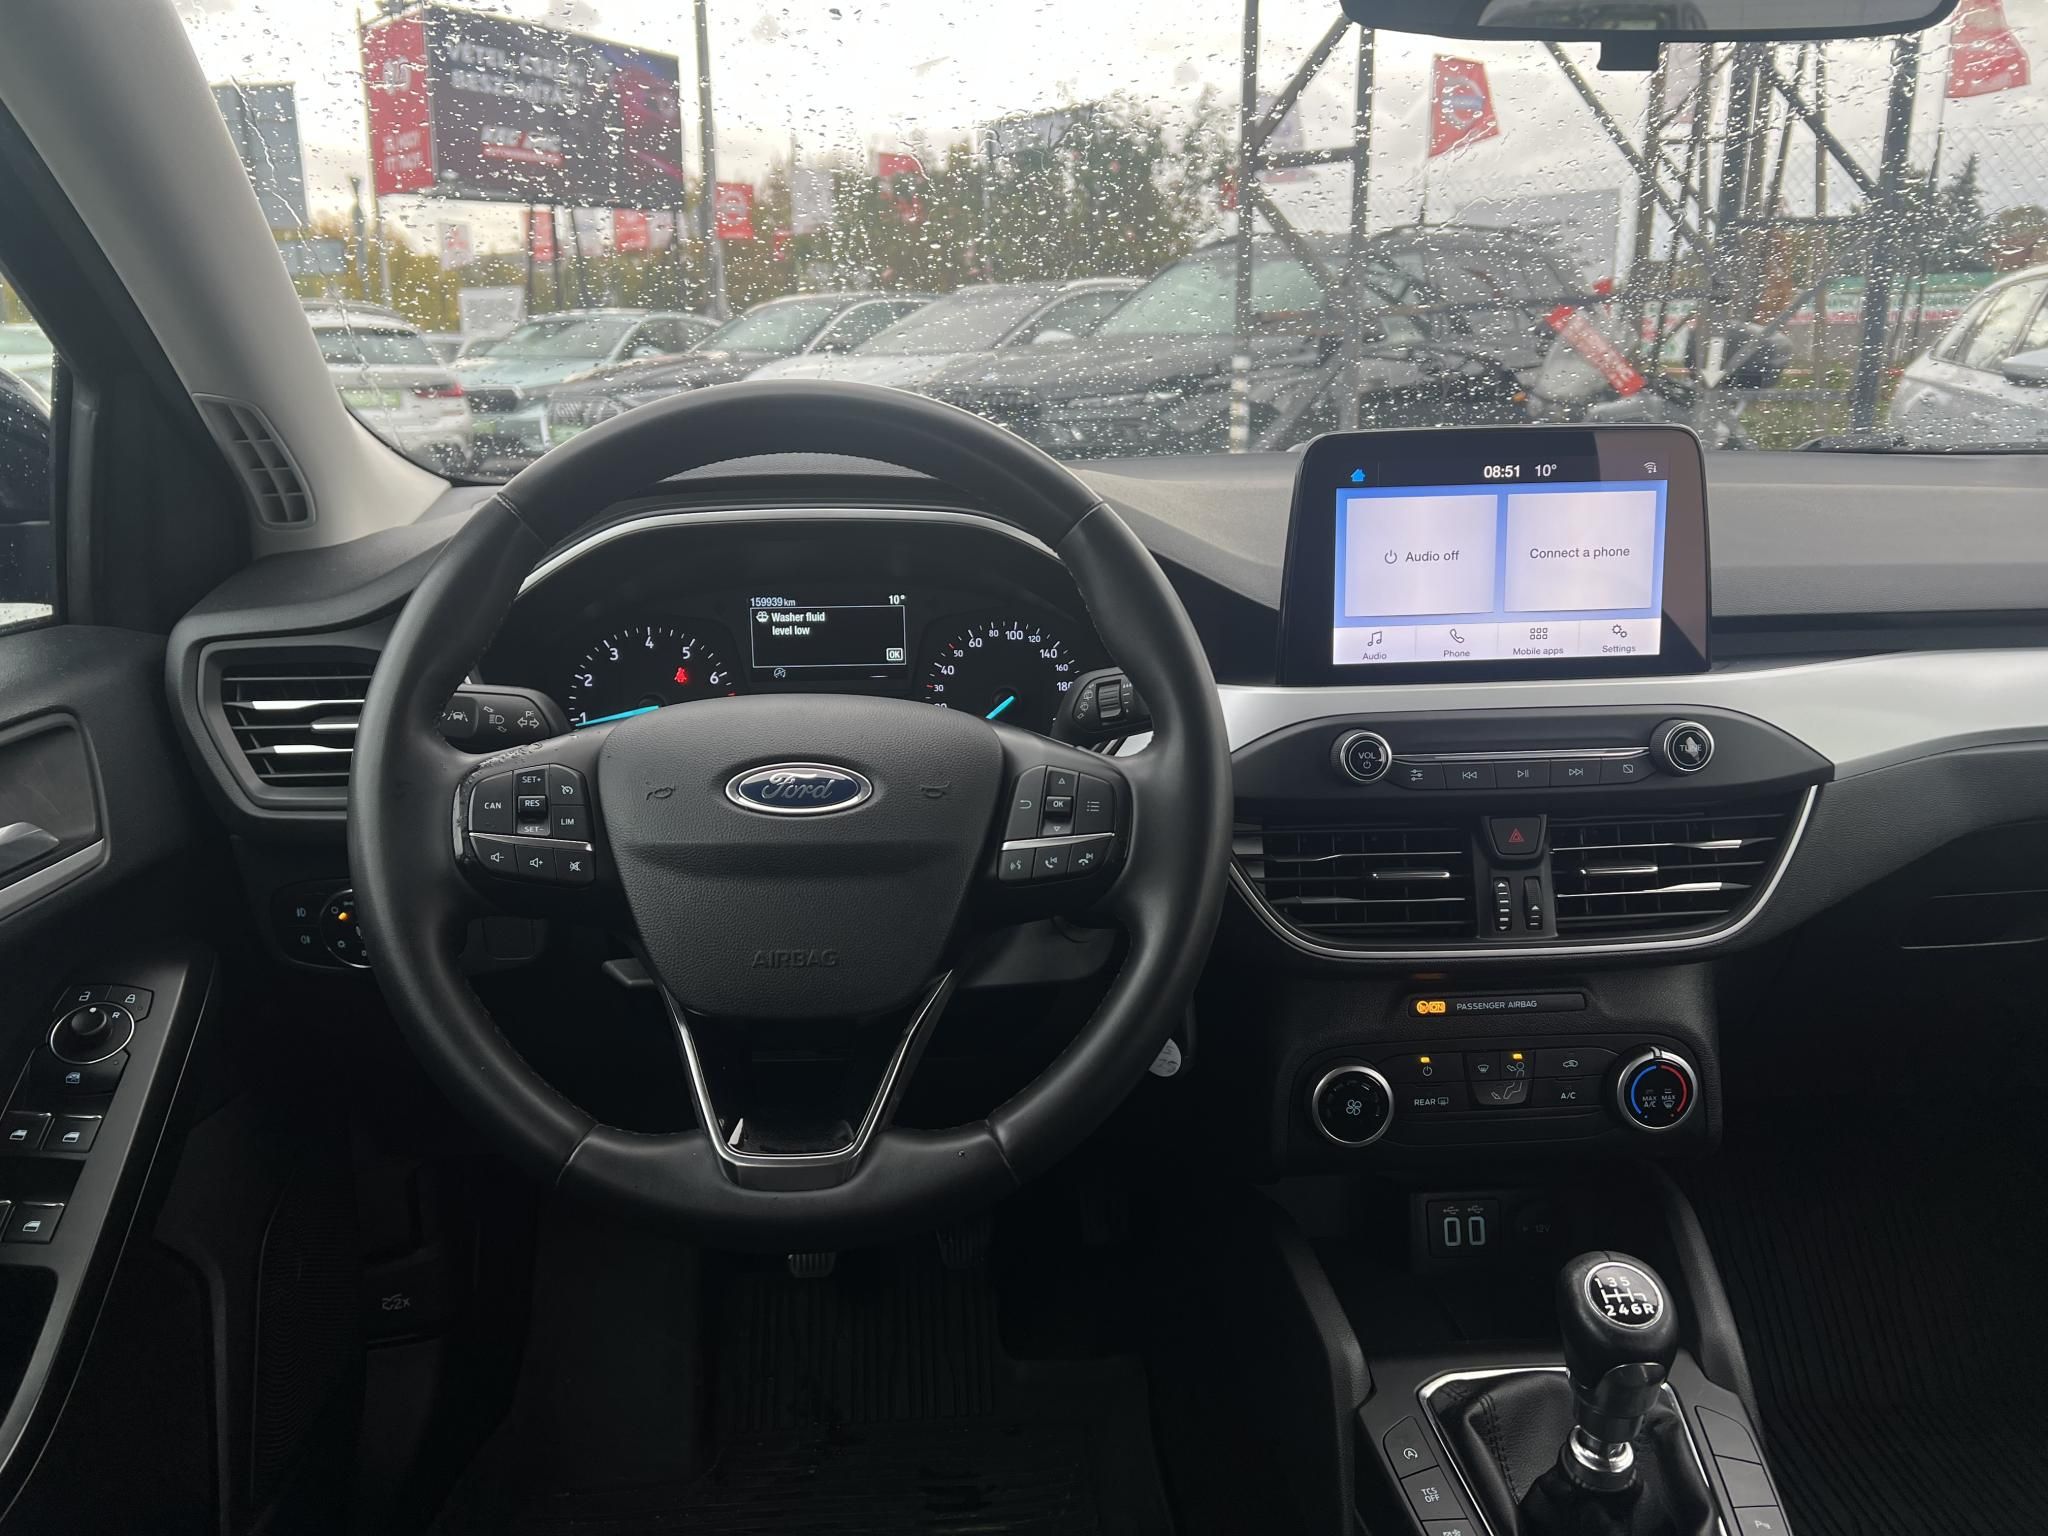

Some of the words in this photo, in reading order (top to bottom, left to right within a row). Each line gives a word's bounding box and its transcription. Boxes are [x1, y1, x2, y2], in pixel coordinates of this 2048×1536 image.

[1484, 464, 1520, 478] 08:51
[1535, 463, 1557, 477] 10°
[1405, 549, 1440, 562] Audio
[1443, 550, 1459, 561] off
[1530, 547, 1579, 560] Connect
[1583, 550, 1591, 559] a
[1593, 546, 1630, 561] phone
[750, 597, 783, 607] 159939
[784, 598, 796, 607] km
[888, 594, 906, 605] 10°
[770, 611, 803, 623] Washer
[806, 611, 826, 622] fluid
[772, 625, 792, 636] level
[794, 625, 810, 635] low
[989, 629, 999, 637] 80
[1005, 630, 1023, 640] 100
[645, 636, 654, 648] 4
[968, 638, 983, 648] 60
[1028, 635, 1041, 643] 120
[609, 648, 619, 660] 3
[682, 646, 691, 659] 5
[953, 649, 964, 657] 50
[1040, 649, 1058, 659] 140
[1443, 648, 1470, 658] Phone
[1513, 646, 1540, 656] Mobile
[1542, 648, 1564, 657] apps
[1602, 644, 1636, 654] Settings
[889, 650, 901, 659] OK
[1362, 650, 1387, 660] Audio
[941, 665, 955, 675] 40
[1055, 664, 1068, 672] 160
[584, 674, 593, 686] 2
[709, 671, 719, 684] 6
[933, 684, 944, 692] 30
[1358, 752, 1376, 760] VOL
[761, 772, 836, 800] Ford
[484, 802, 502, 810] CAN
[752, 950, 839, 969] AIRBAG
[1456, 1000, 1505, 1010] PASSENGER
[1508, 1000, 1538, 1009] AIRBAG
[112, 1011, 120, 1019] R
[1560, 1091, 1576, 1100] A/C
[1414, 1098, 1436, 1106] REAR
[1594, 1277, 1603, 1288] 1
[1608, 1276, 1618, 1287] 3
[1619, 1276, 1630, 1287] 5
[1604, 1304, 1617, 1317] 2
[1618, 1303, 1630, 1316] 4
[1630, 1303, 1643, 1315] 6
[1642, 1303, 1655, 1315] R
[1421, 1487, 1438, 1496] TCS
[1424, 1494, 1440, 1503] OFF
